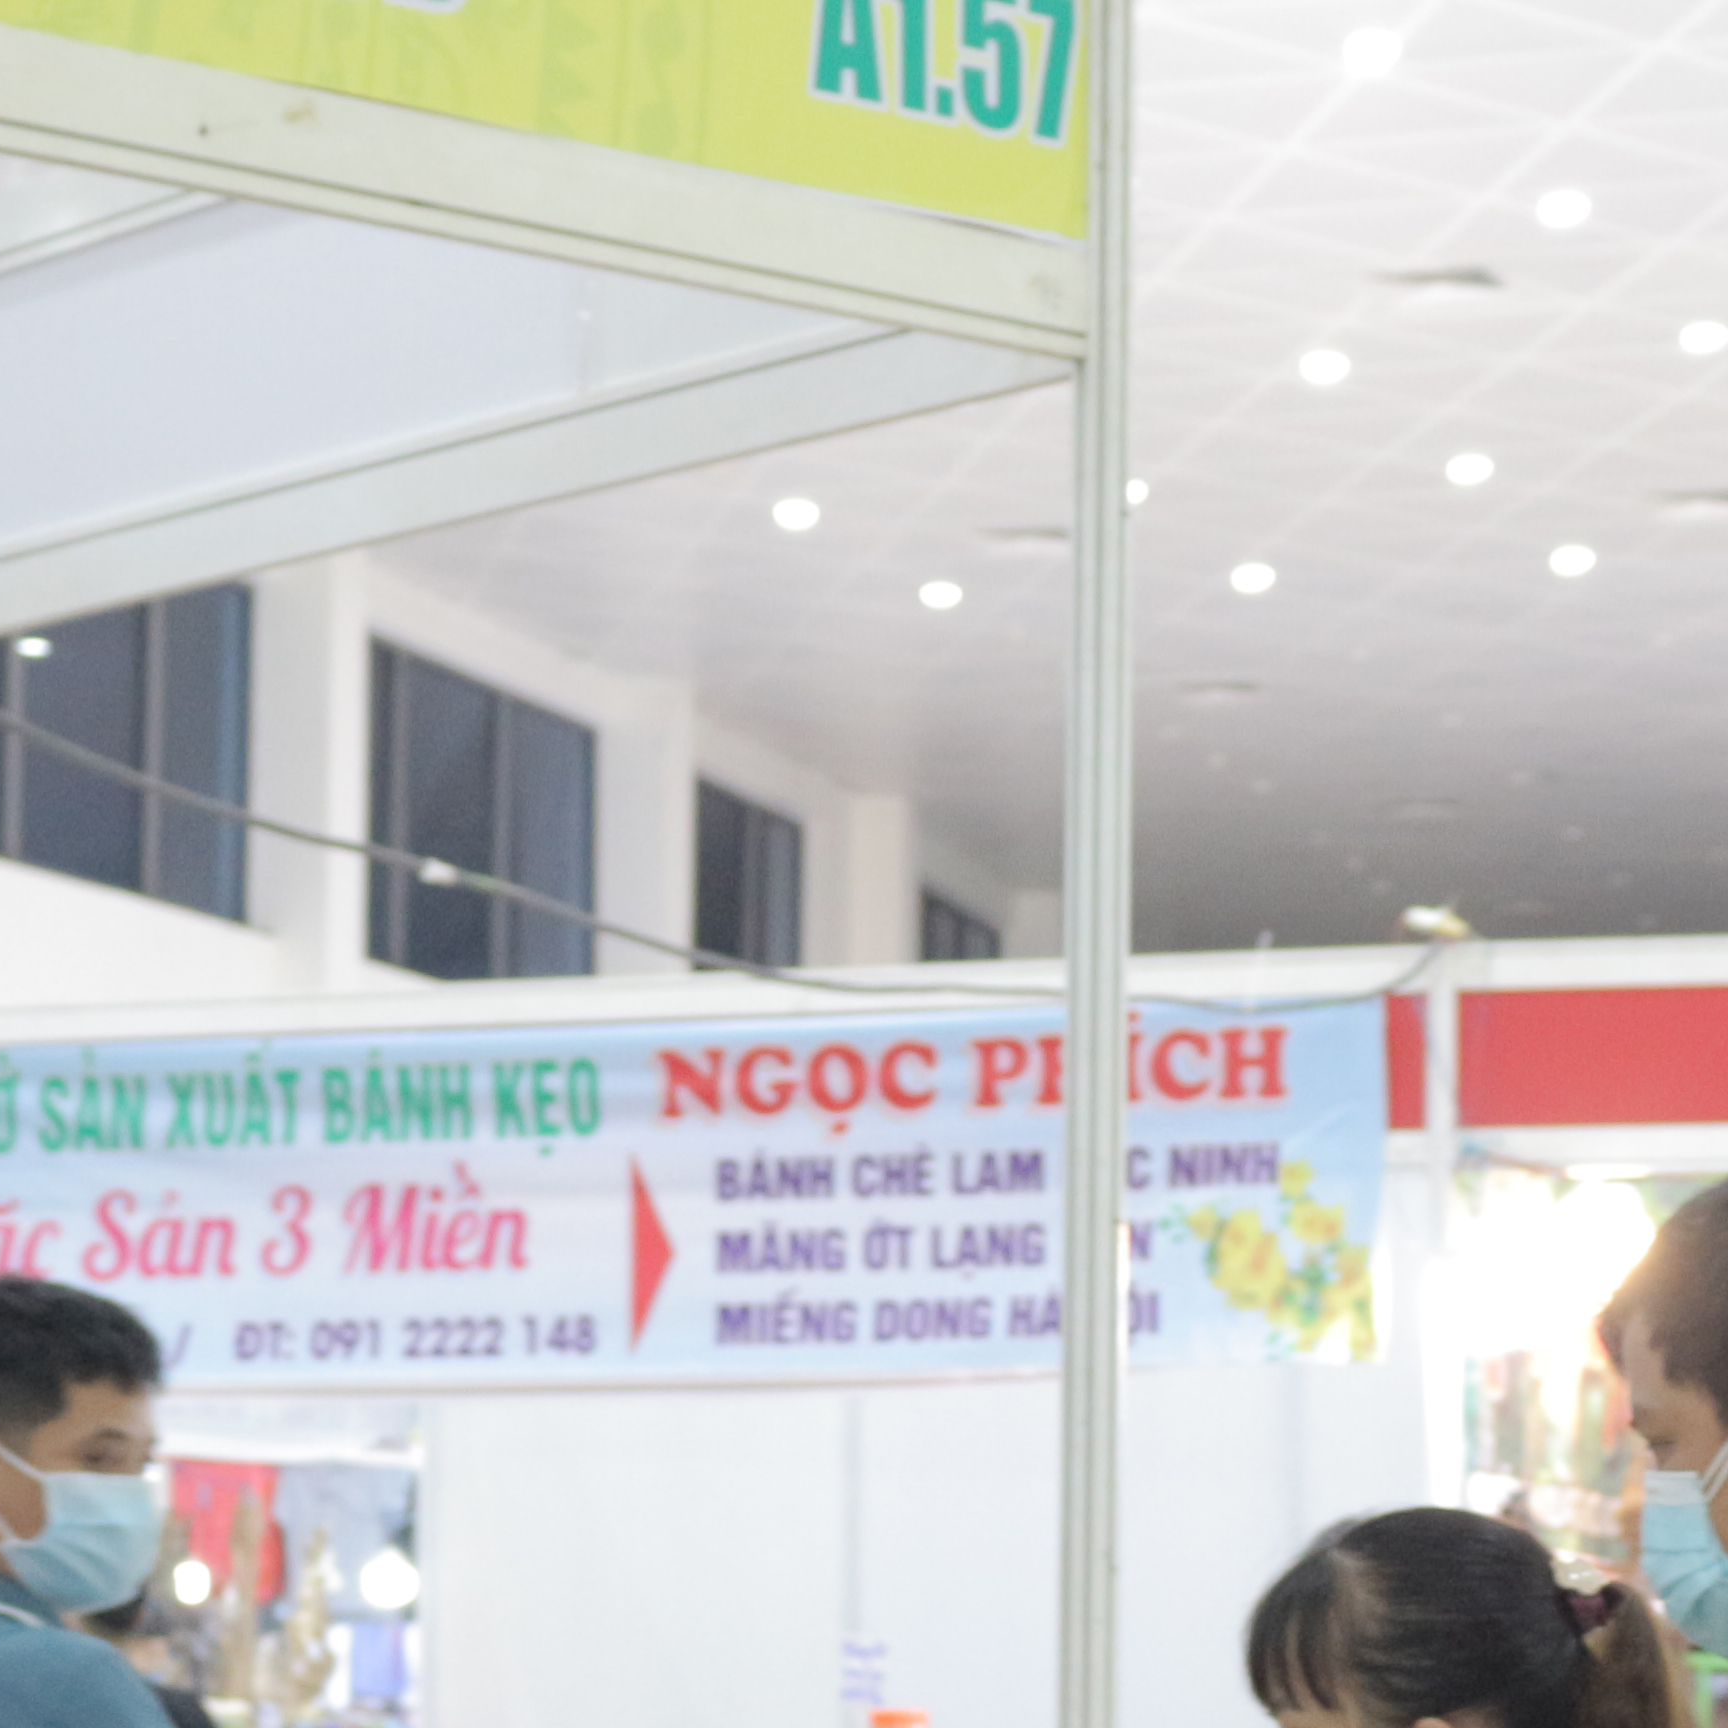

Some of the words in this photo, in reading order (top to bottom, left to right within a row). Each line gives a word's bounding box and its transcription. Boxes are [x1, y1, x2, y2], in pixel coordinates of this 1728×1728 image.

[814, 0, 1074, 141] A1.57
[39, 1047, 147, 1152] SẢN
[165, 1040, 301, 1149] XUẤT
[322, 1047, 474, 1145] BÁNH
[490, 1057, 603, 1157] KẸO
[655, 1039, 940, 1136] NGỌC
[953, 1148, 1045, 1195] LAM
[1167, 1141, 1280, 1190] NINH
[261, 1184, 314, 1277] 3
[342, 1160, 530, 1275] Miền
[309, 1318, 382, 1361] 091
[400, 1315, 505, 1360] 2222
[522, 1313, 598, 1356] 148
[874, 1296, 992, 1343] DONG
